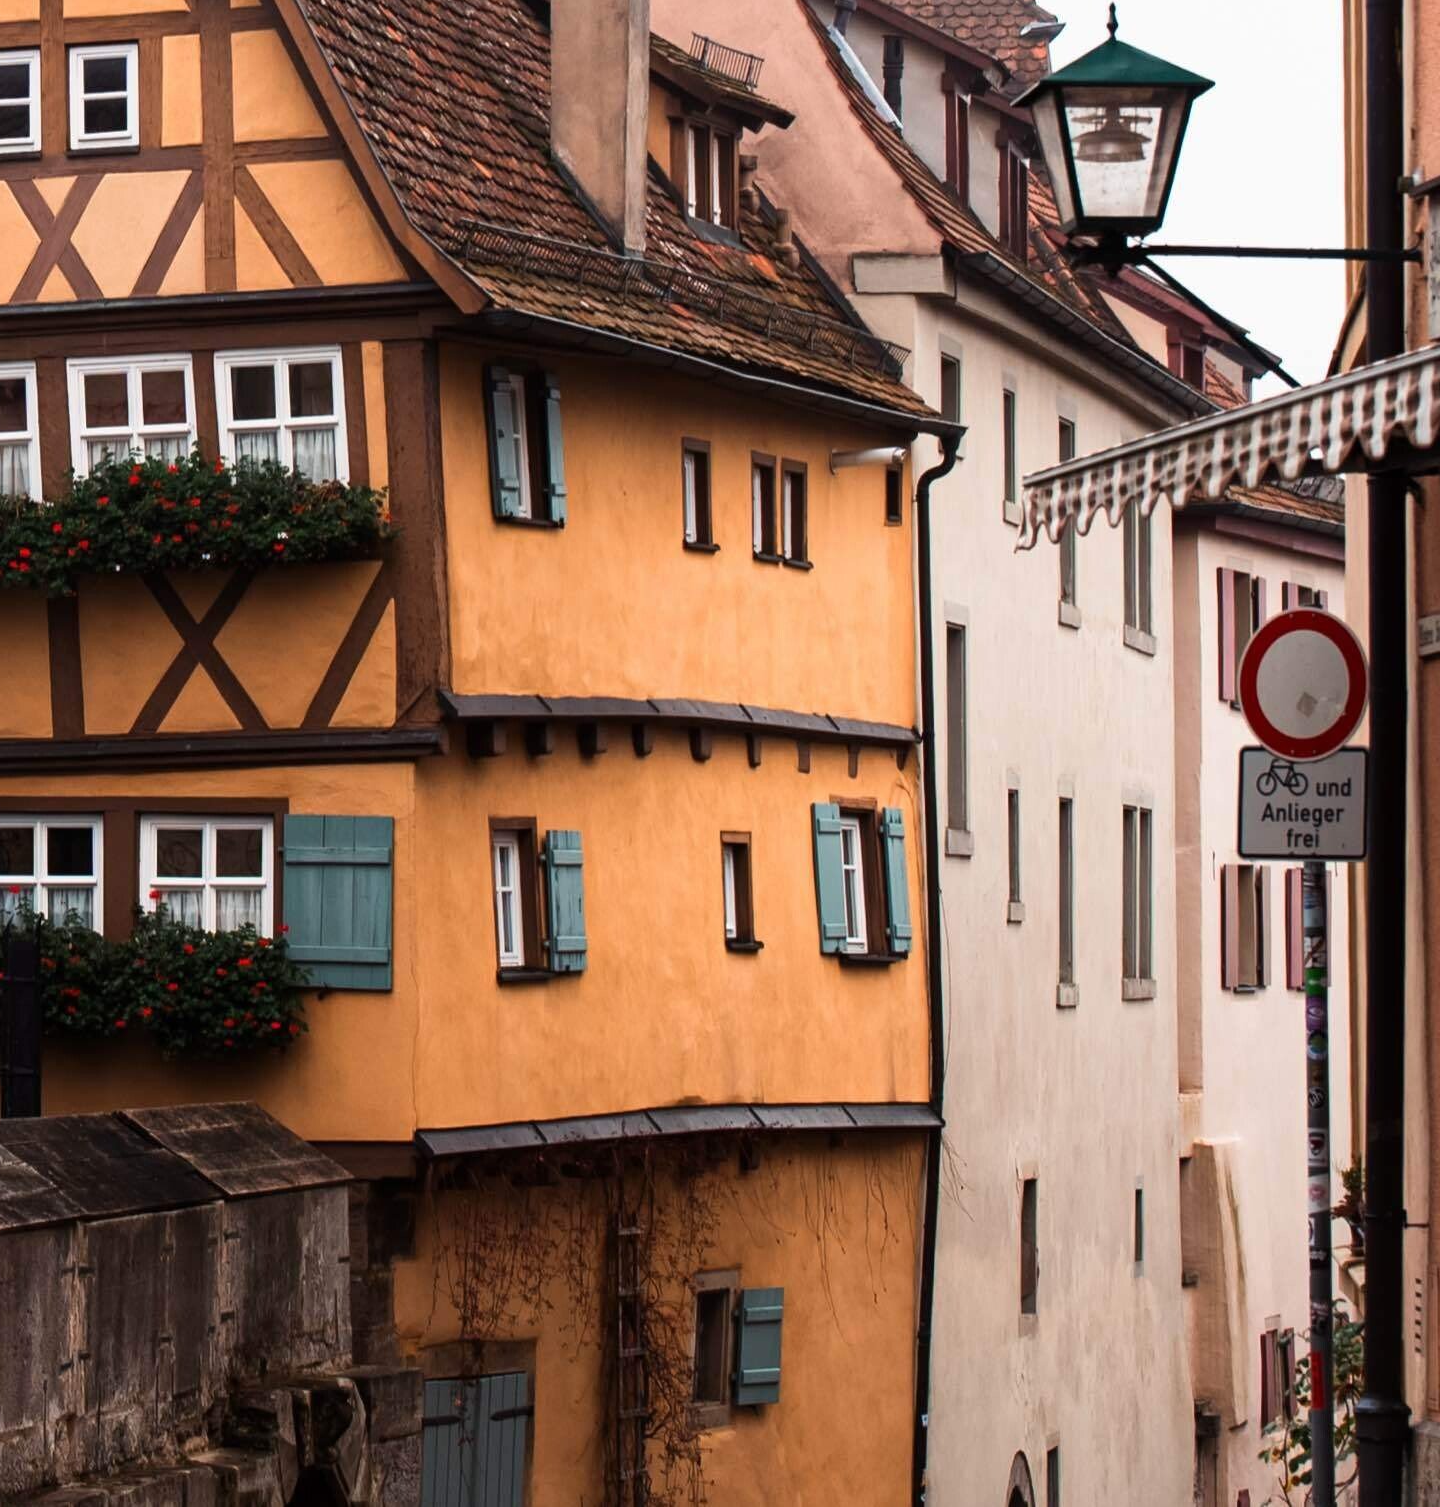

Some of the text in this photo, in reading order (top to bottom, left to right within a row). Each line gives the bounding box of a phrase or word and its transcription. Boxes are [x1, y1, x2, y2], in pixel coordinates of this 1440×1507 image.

[1316, 777, 1352, 797] und
[1261, 802, 1345, 828] Anlieger
[1286, 828, 1320, 848] frei
